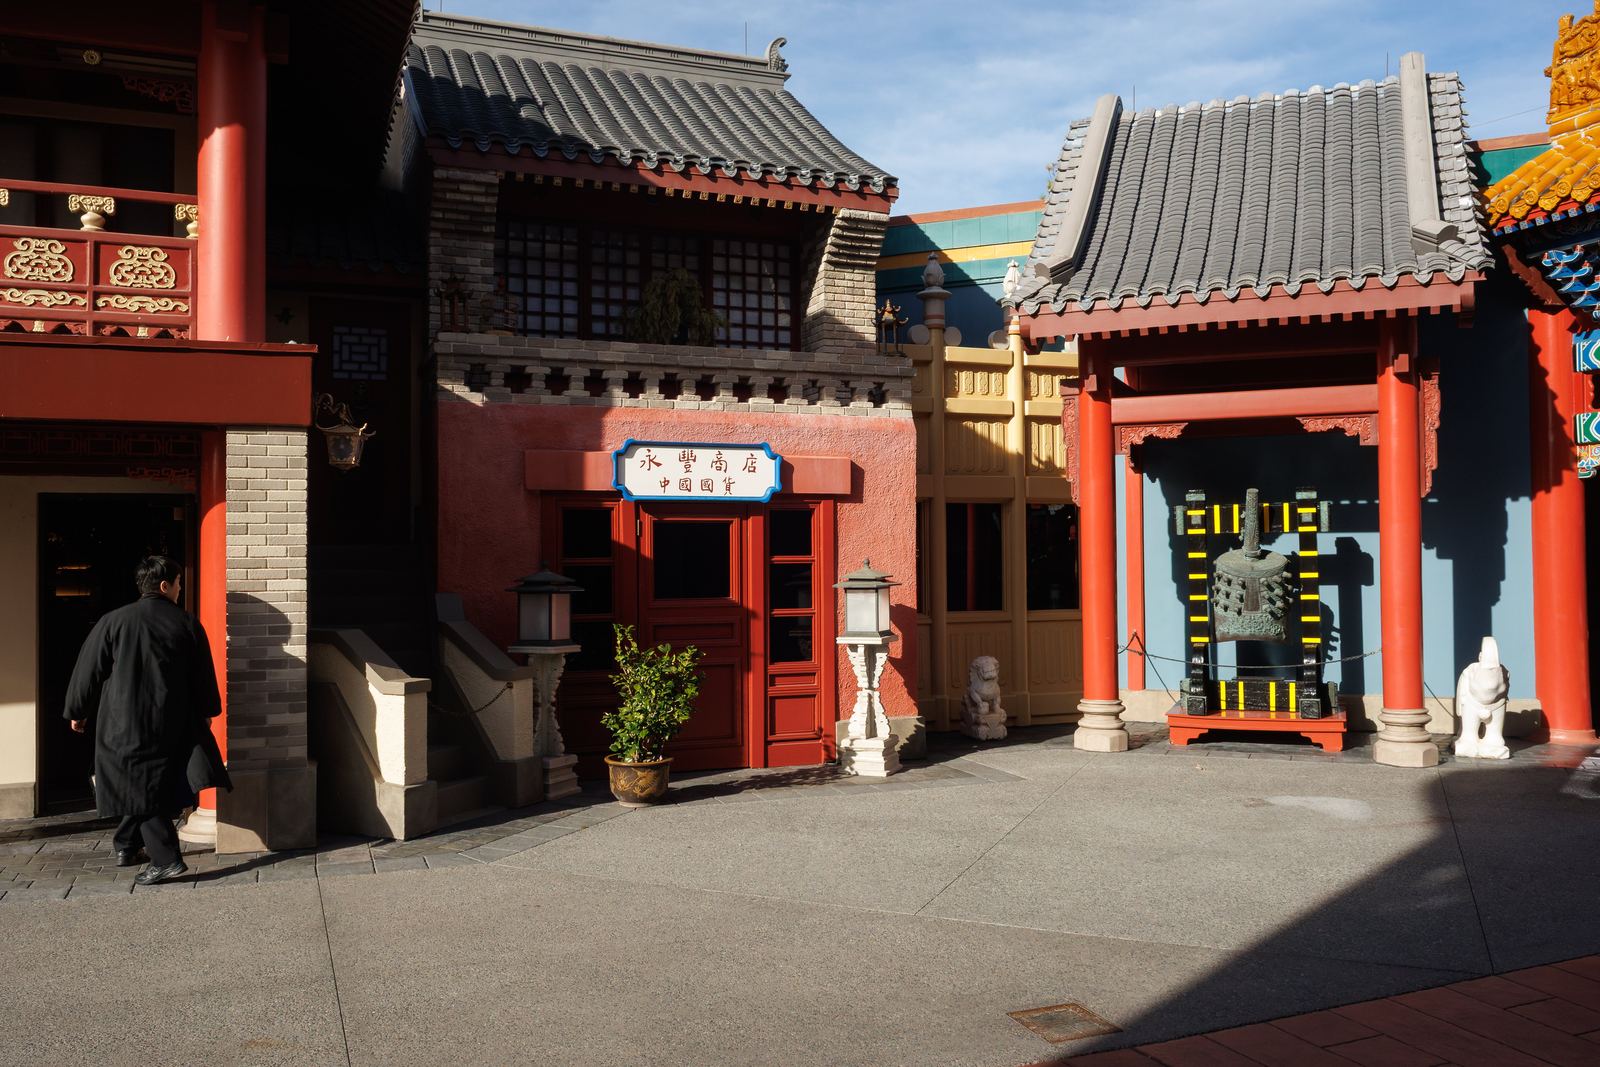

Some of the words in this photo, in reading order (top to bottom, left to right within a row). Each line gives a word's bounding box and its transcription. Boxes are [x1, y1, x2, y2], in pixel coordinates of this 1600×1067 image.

[639, 448, 758, 474] 永豐商店
[659, 476, 736, 495] 中國國貨
